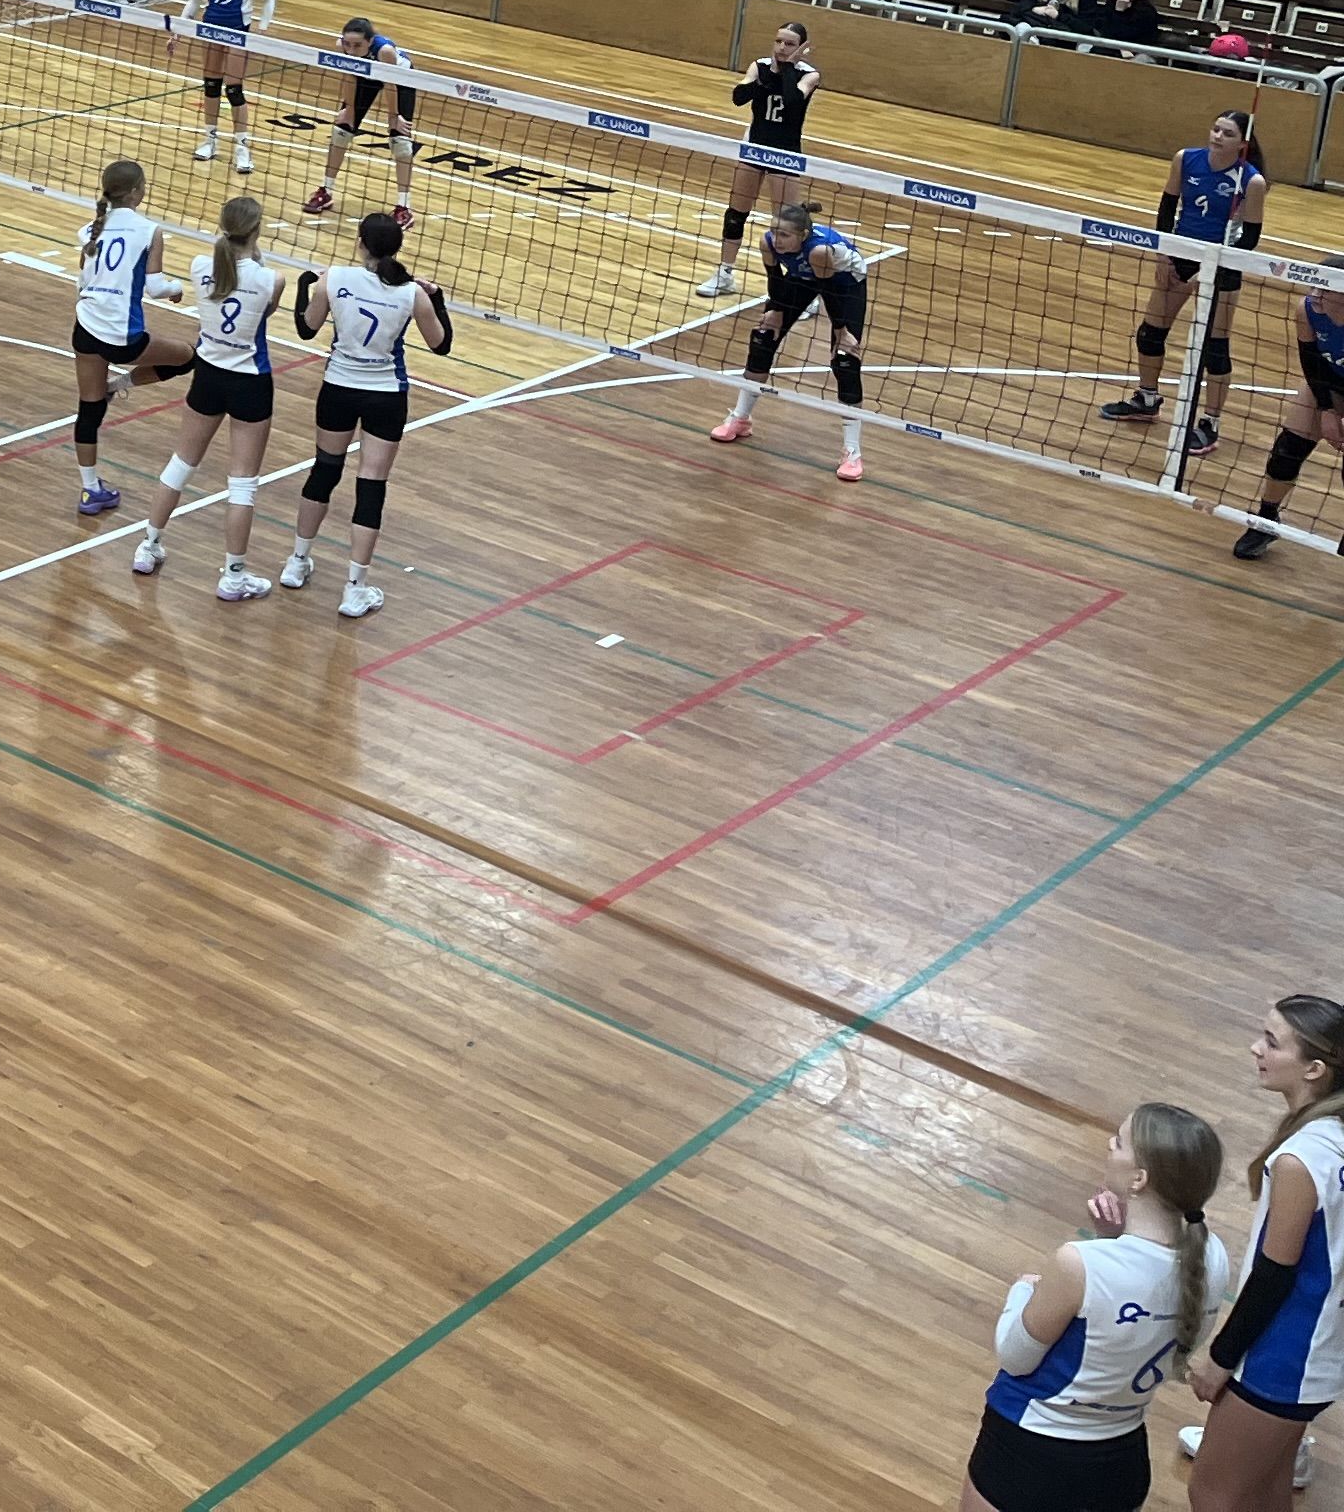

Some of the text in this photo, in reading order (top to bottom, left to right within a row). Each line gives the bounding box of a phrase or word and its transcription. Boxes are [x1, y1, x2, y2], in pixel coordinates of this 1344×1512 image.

[213, 29, 244, 45] UNIQA
[336, 58, 369, 75] UNIQA
[765, 94, 785, 123] 12
[609, 118, 645, 136] UNIQA
[762, 152, 801, 170] UNIQA
[929, 188, 971, 208] UNIQA
[1108, 227, 1153, 248] UNIQA
[94, 236, 125, 276] 10
[1288, 261, 1320, 276] ČESKÝ
[1287, 270, 1330, 288] VOLEJBAL
[220, 297, 242, 335] 8
[358, 306, 379, 347] 7
[1131, 1338, 1179, 1394] 6
